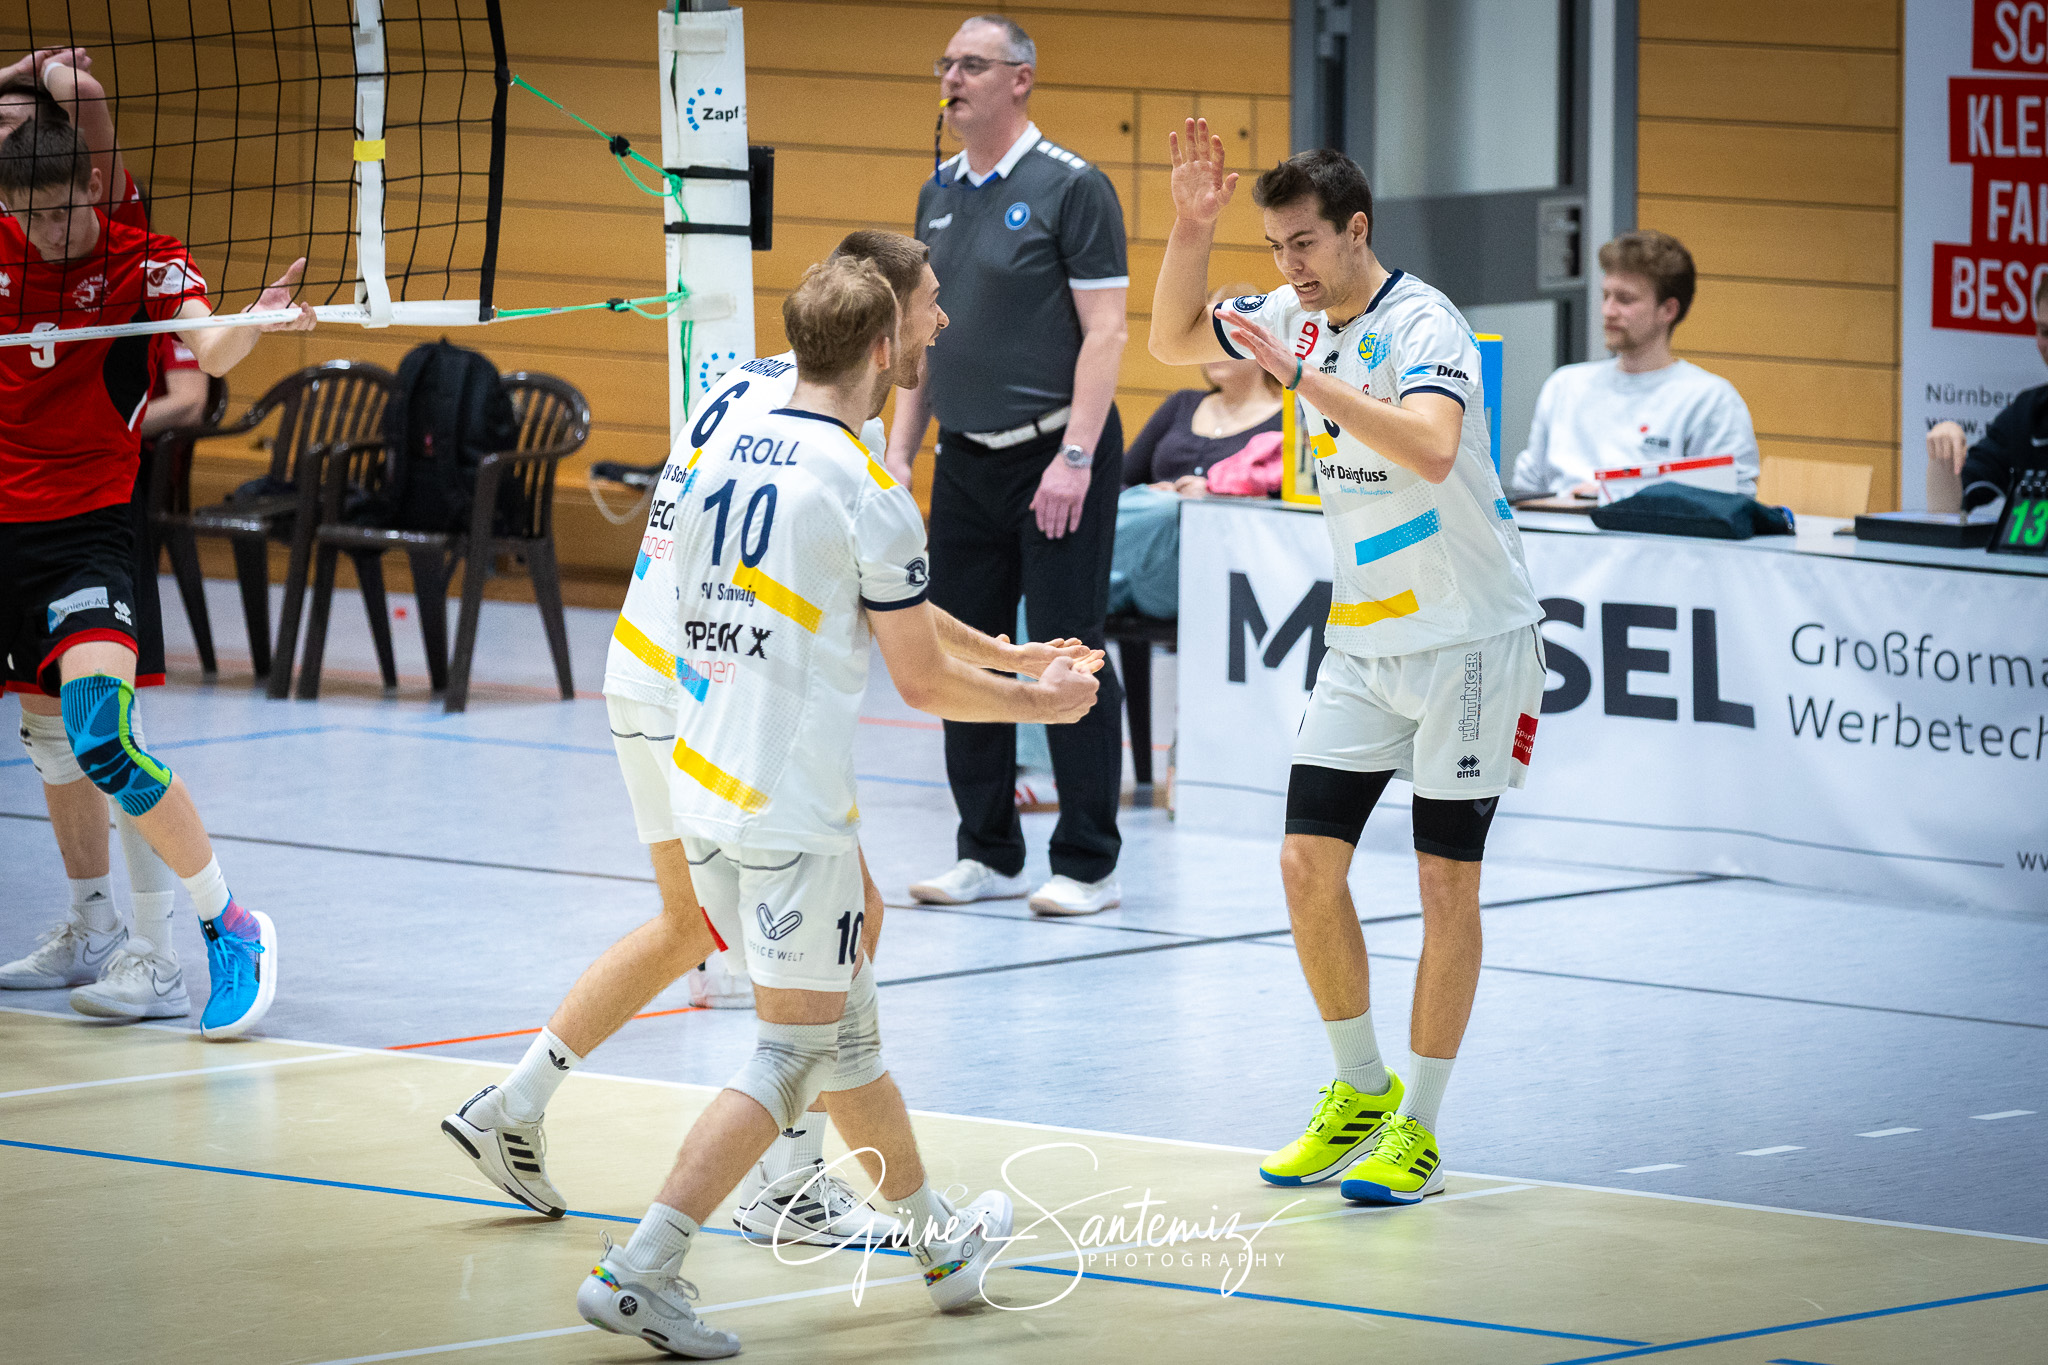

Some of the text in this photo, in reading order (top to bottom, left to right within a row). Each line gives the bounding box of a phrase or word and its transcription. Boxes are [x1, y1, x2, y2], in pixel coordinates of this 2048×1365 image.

[1992, 1, 2048, 64] SC
[702, 105, 739, 122] Zapf
[1967, 94, 2048, 158] KLE
[30, 322, 57, 368] 9
[690, 381, 750, 449] 6
[729, 434, 800, 466] ROLL
[1319, 459, 1388, 485] Zapf Daigfuss
[702, 478, 778, 569] 10
[2008, 499, 2048, 546] 13
[685, 620, 744, 654] SPECK
[1227, 569, 1756, 730] MSEL
[1457, 651, 1478, 742] HÜTTINGER
[837, 910, 864, 965] 10
